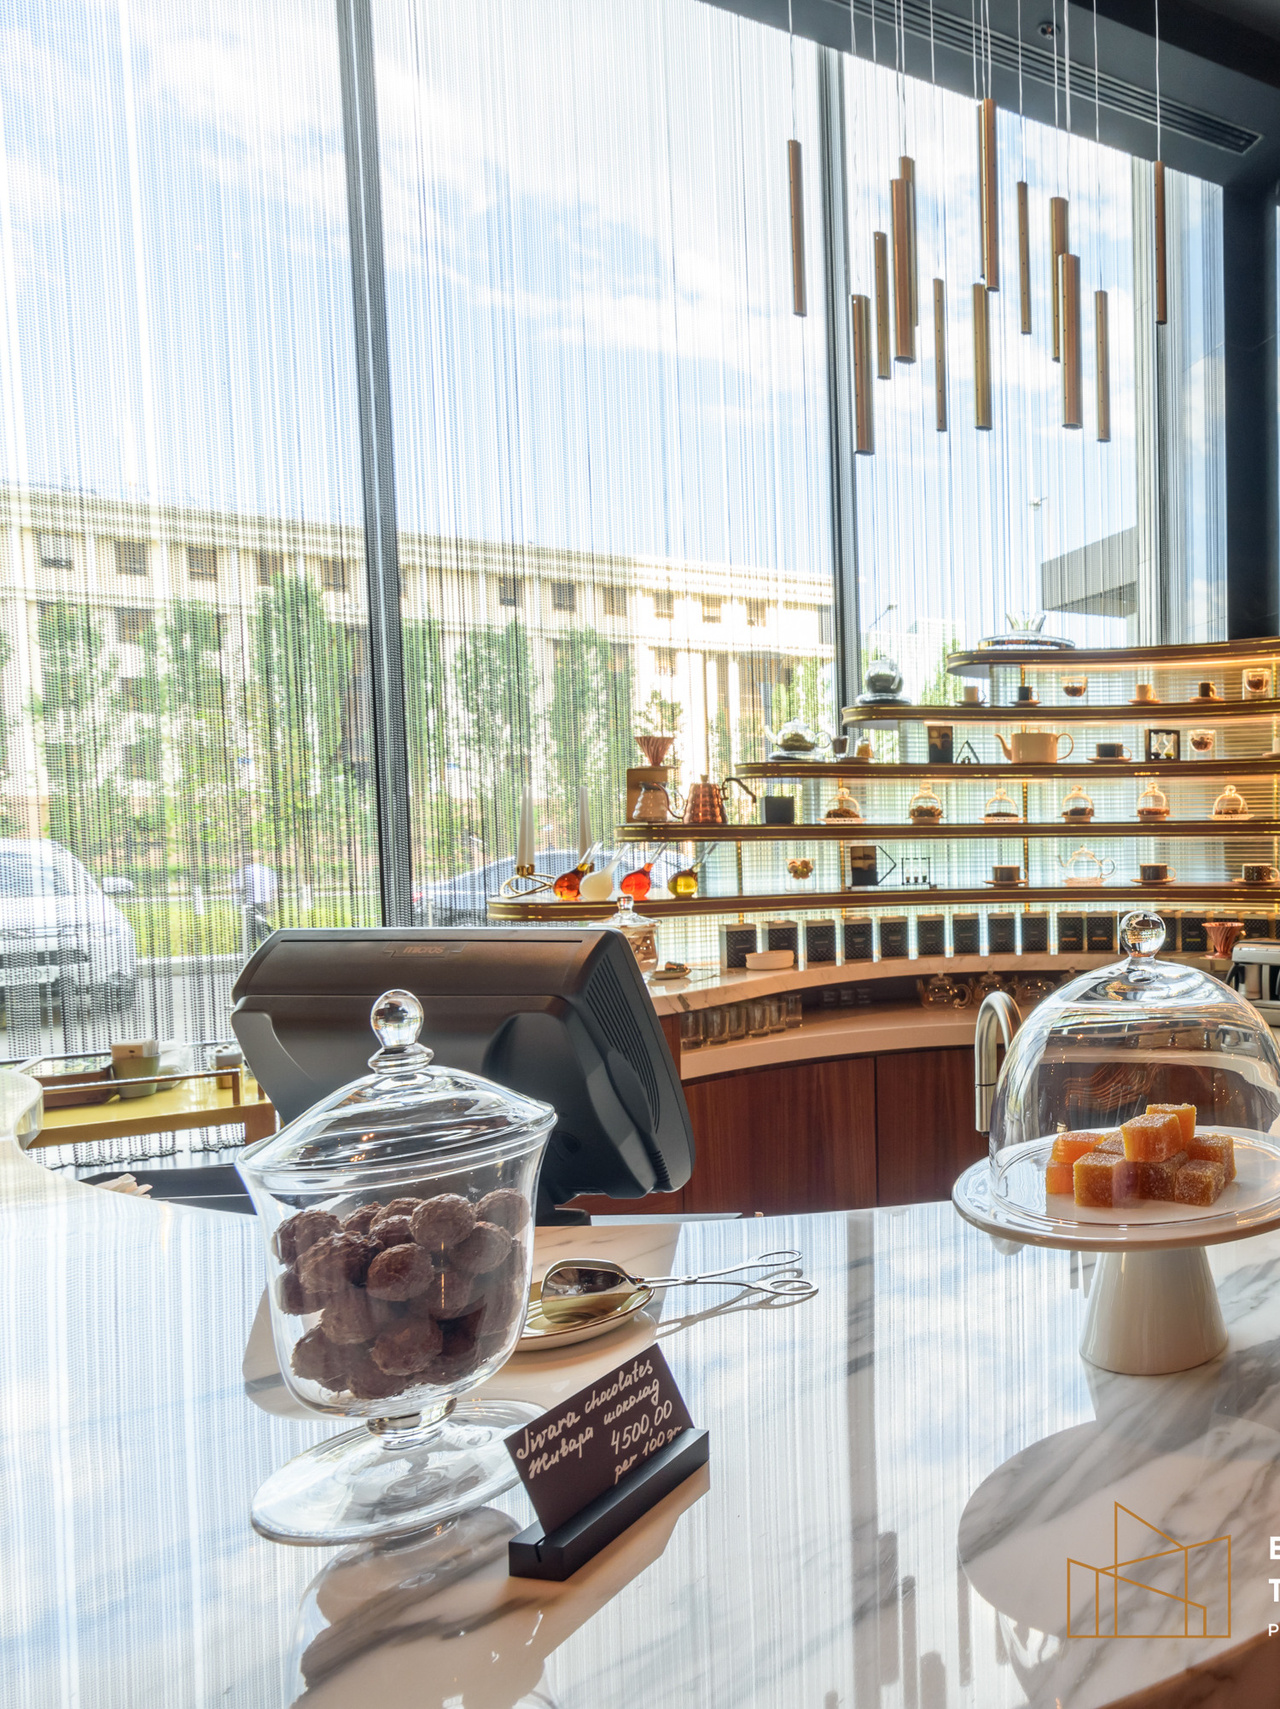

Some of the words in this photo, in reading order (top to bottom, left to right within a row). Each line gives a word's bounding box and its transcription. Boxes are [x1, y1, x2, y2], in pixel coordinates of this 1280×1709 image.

[402, 945, 446, 954] micros
[516, 1411, 581, 1460] Jivara
[584, 1359, 653, 1414] chocolates
[528, 1426, 594, 1479] Живара
[603, 1378, 660, 1425] шоколад
[610, 1399, 673, 1455] 4500,00
[614, 1453, 638, 1485] per
[642, 1431, 665, 1457] 100
